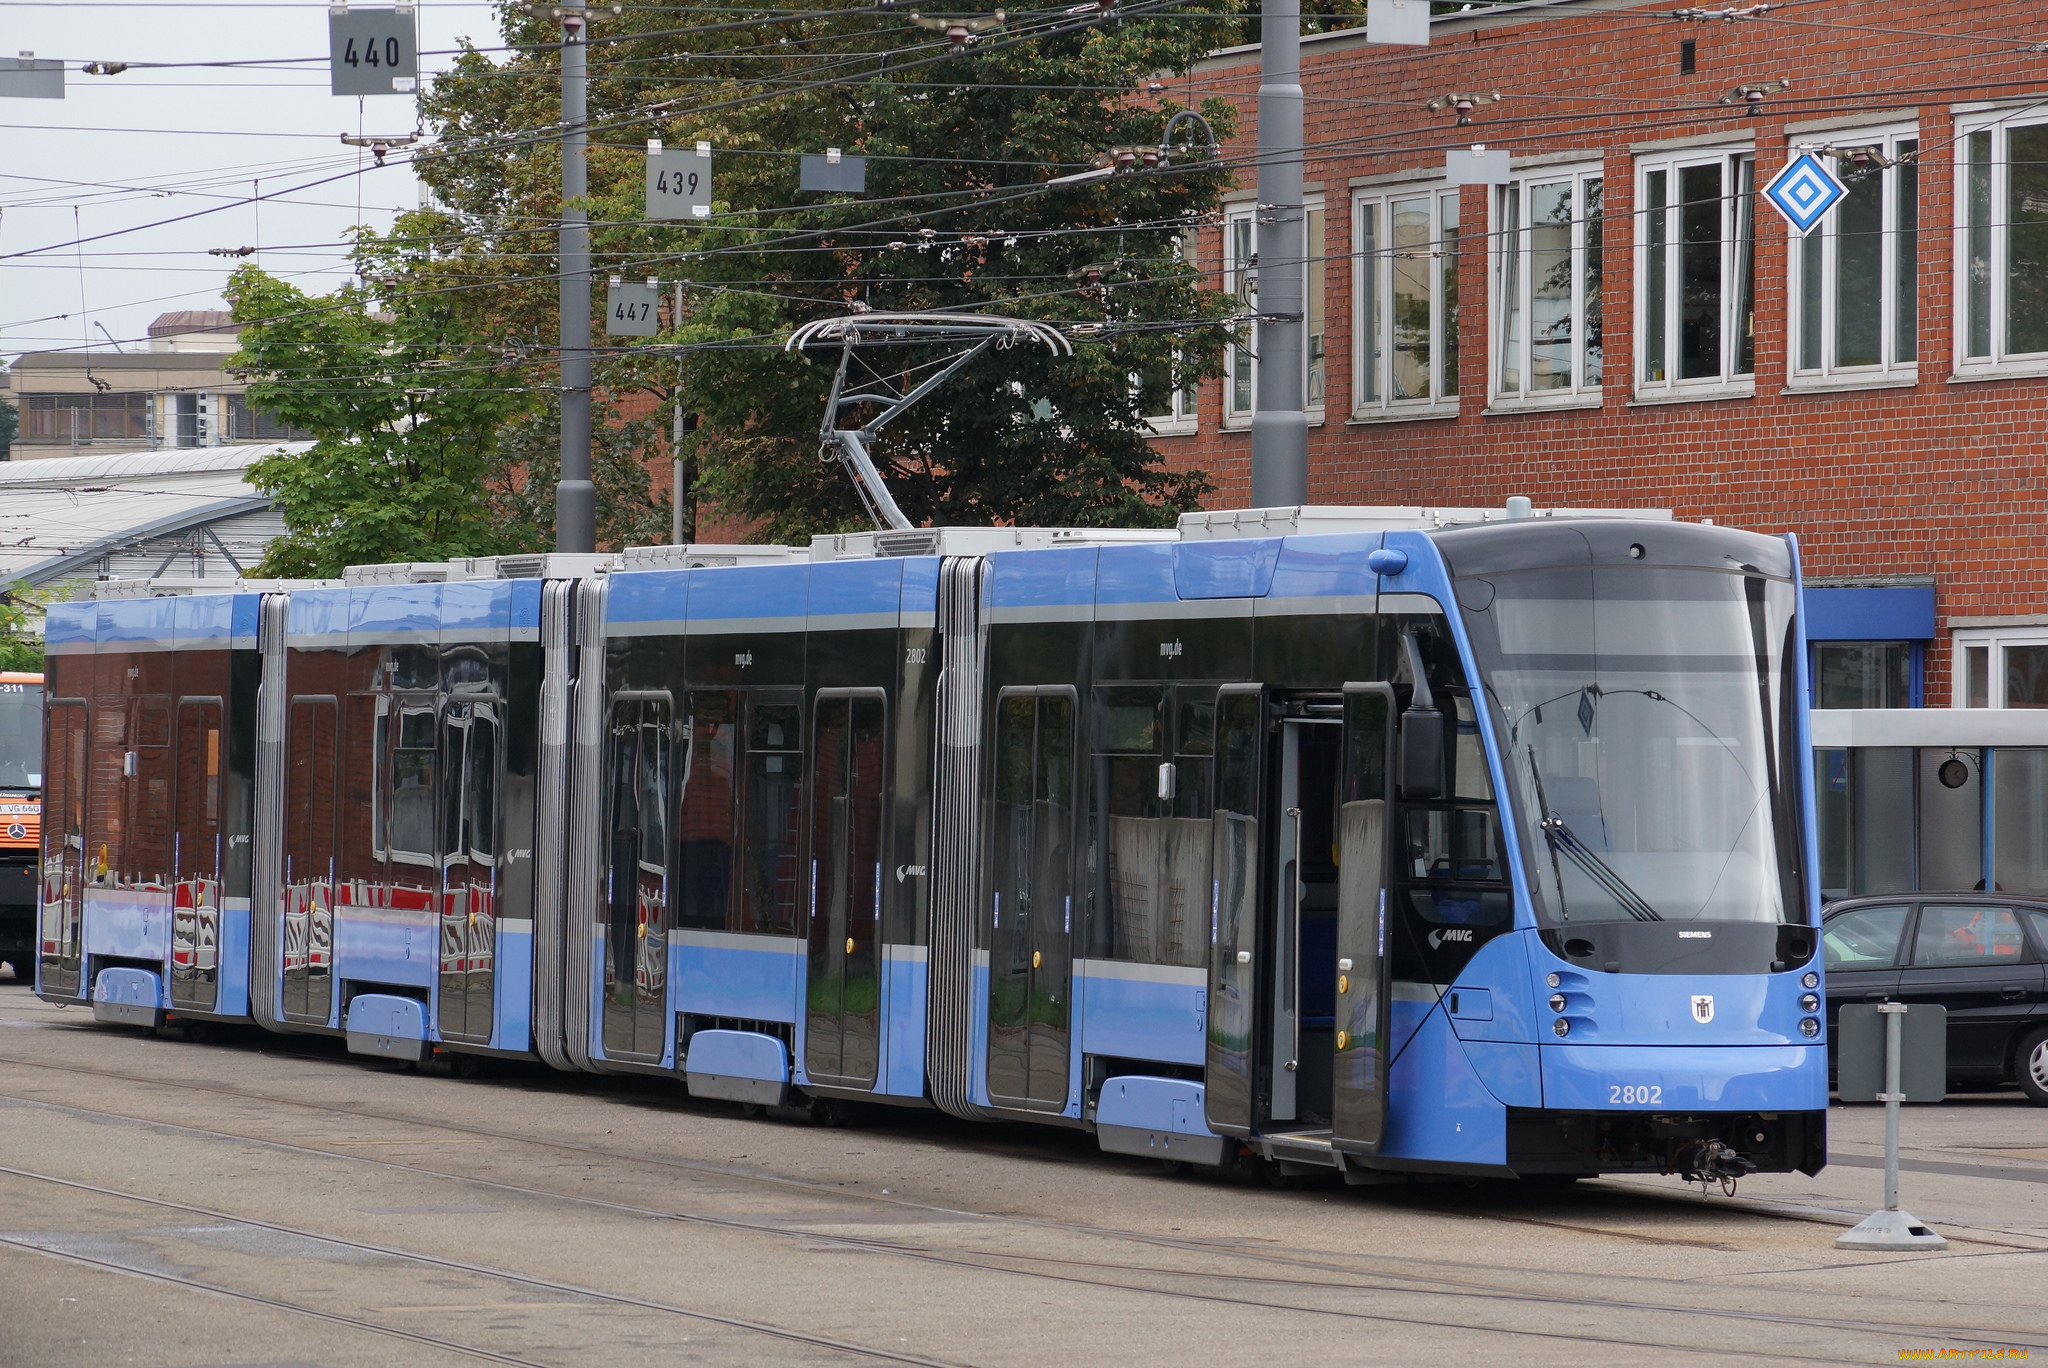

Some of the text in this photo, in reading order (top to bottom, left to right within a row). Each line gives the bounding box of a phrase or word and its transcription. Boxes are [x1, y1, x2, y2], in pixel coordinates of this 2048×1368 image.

[344, 37, 400, 68] 440
[656, 170, 699, 196] 439
[615, 303, 651, 321] 447
[906, 648, 926, 664] 2802
[1160, 638, 1182, 660] mvg.de
[735, 649, 753, 669] mvg.de
[234, 834, 249, 843] MVG
[514, 848, 531, 858] MVG
[905, 865, 926, 876] MVG
[1442, 929, 1473, 942] MVG
[1609, 1085, 1662, 1104] 2802
